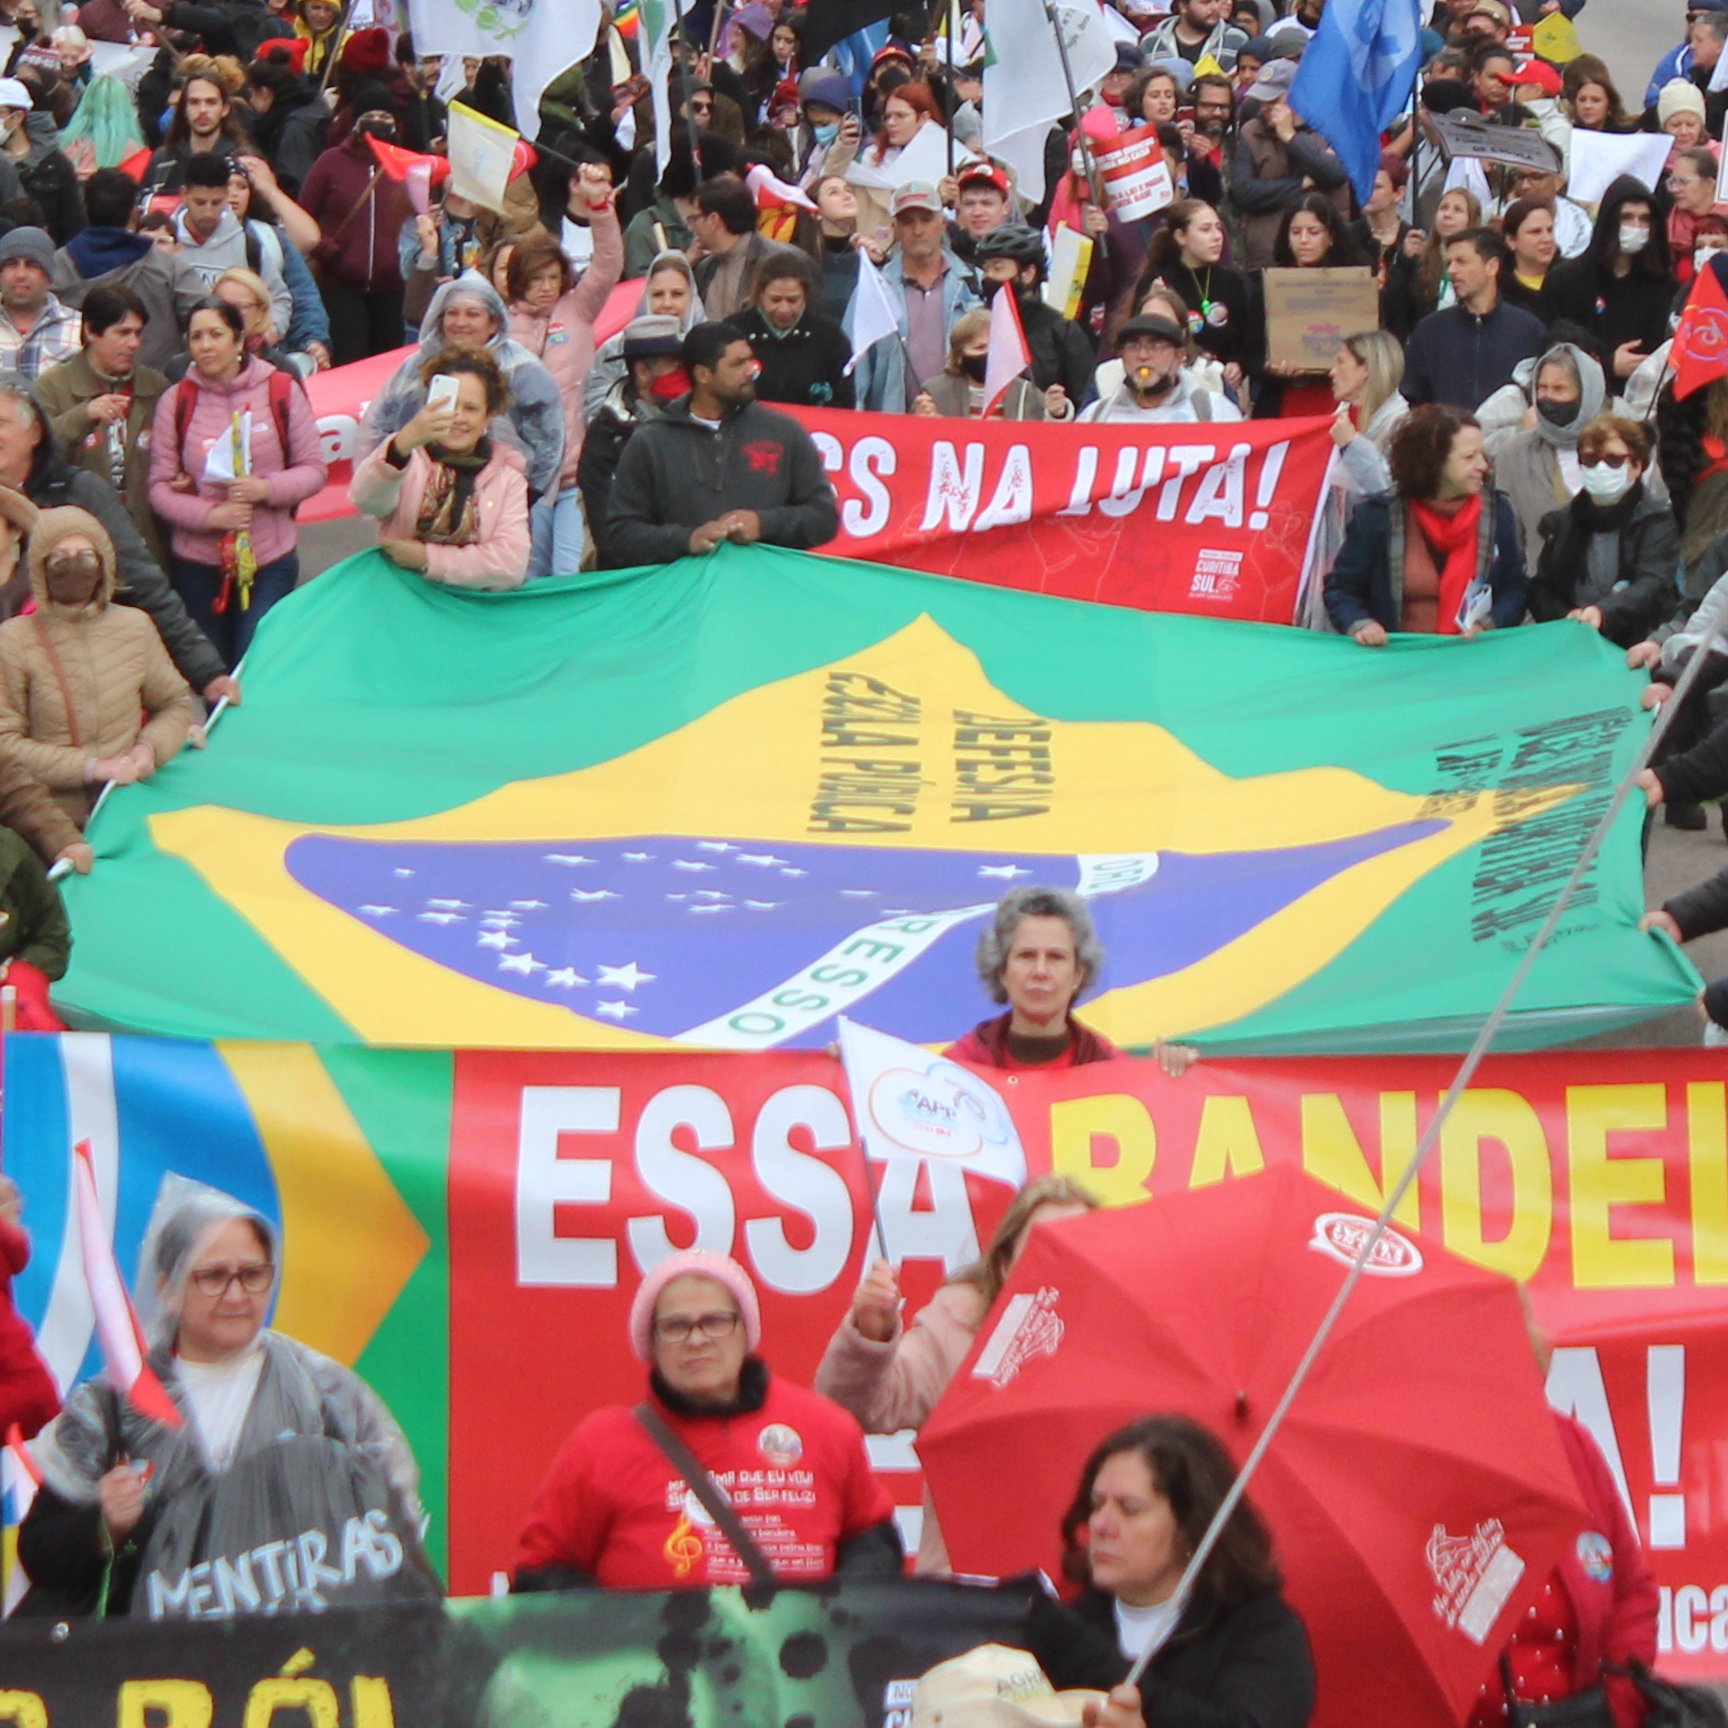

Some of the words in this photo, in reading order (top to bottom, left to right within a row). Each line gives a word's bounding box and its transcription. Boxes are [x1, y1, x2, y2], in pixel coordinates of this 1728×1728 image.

[920, 439, 1034, 533] NA
[1057, 439, 1290, 530] LUTA!
[1196, 558, 1239, 576] CURITIBA
[917, 1096, 958, 1119] APP
[516, 1083, 984, 1294] ESSA
[739, 1469, 765, 1484] QUE
[768, 1469, 786, 1483] EU
[734, 1490, 752, 1504] DE
[147, 1508, 404, 1621] MENTIRAS
